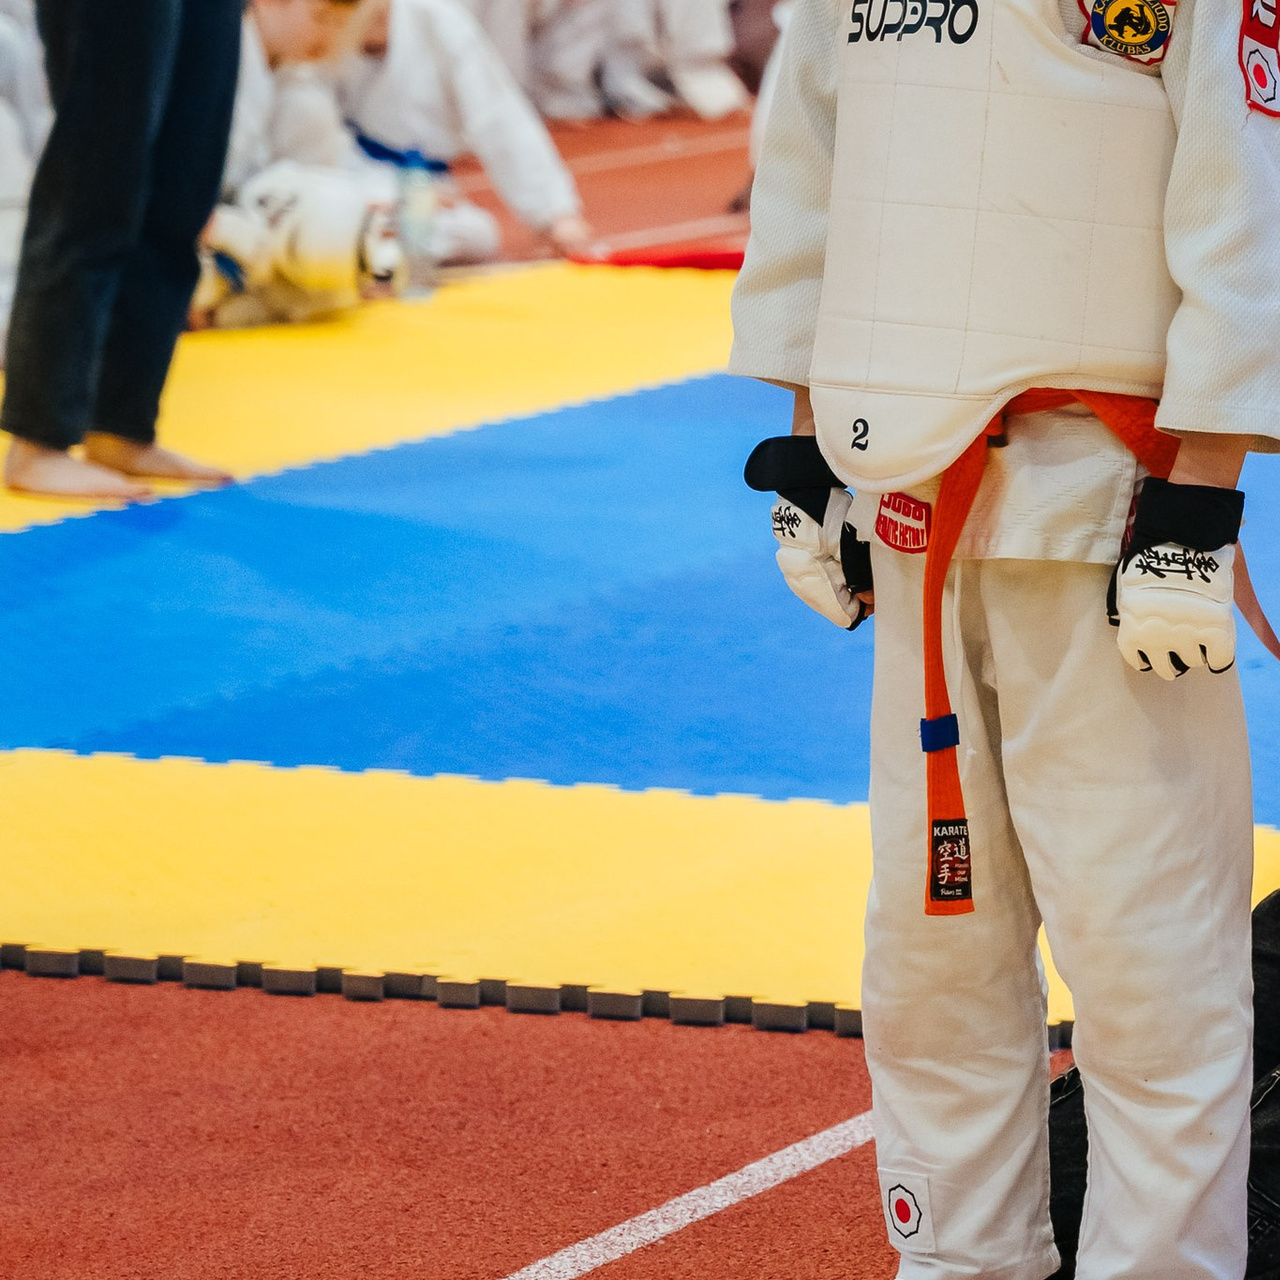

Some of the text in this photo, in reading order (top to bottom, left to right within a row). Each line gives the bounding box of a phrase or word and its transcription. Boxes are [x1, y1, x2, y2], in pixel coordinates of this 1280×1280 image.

[1100, 34, 1151, 55] KLUBAS
[851, 418, 869, 451] 2
[882, 493, 924, 522] JUDO
[933, 825, 968, 837] KARATE
